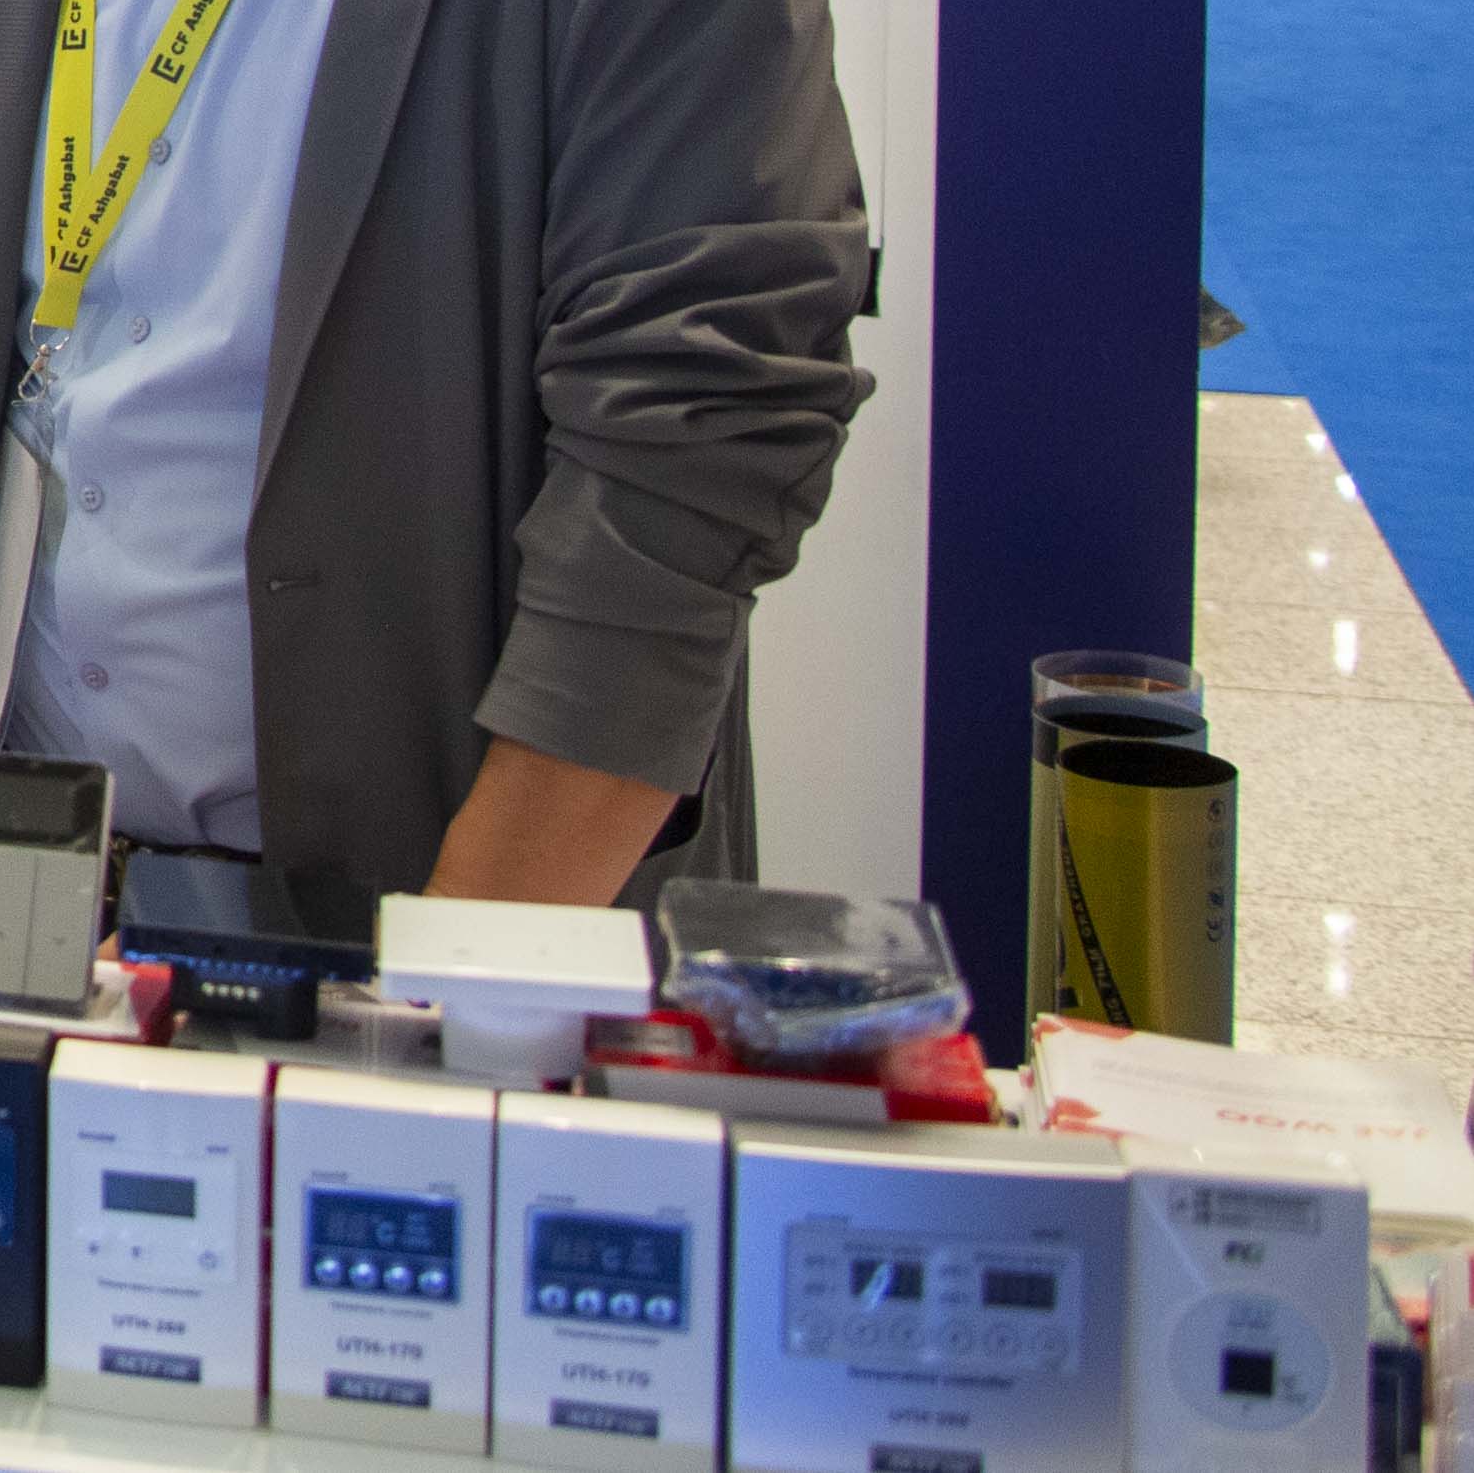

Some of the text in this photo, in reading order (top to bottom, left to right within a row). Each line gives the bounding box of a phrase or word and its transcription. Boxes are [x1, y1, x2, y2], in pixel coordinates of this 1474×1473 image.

[69, 1, 83, 23] CF
[171, 30, 192, 56] CF
[58, 136, 76, 214] Ashgabat
[76, 154, 131, 249] CF Ashgabat
